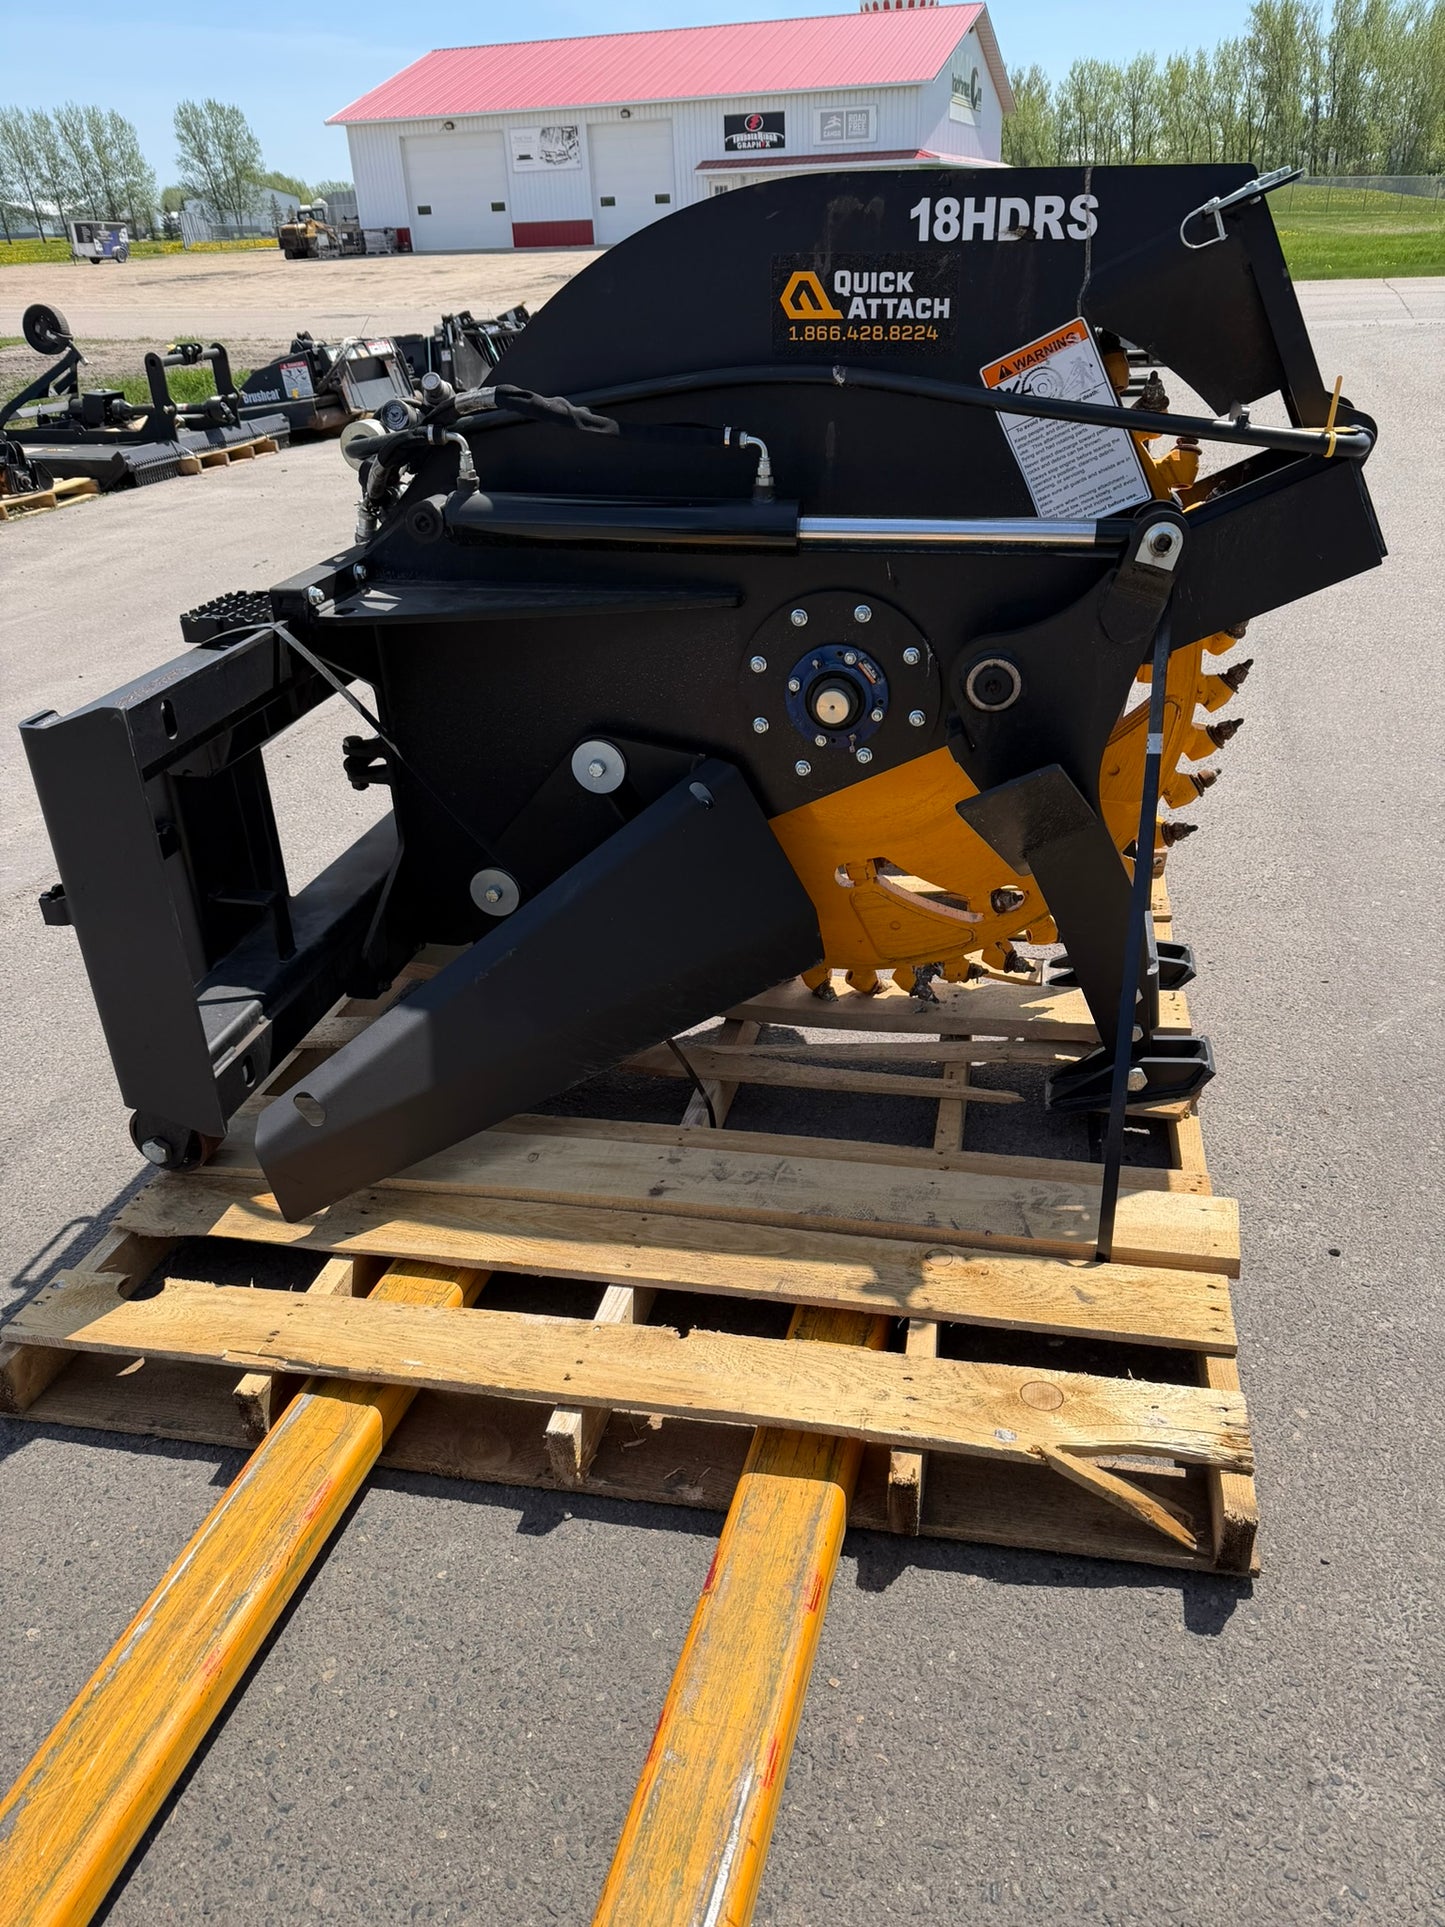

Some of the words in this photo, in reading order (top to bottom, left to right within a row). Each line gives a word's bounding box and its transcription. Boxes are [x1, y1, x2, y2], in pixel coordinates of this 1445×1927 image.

[910, 194, 1100, 243] 18HDRS
[833, 270, 915, 297] QUICK
[847, 297, 950, 320] ATTACH
[788, 324, 939, 342] 1.866.428.8224
[1012, 332, 1078, 371] WARNING
